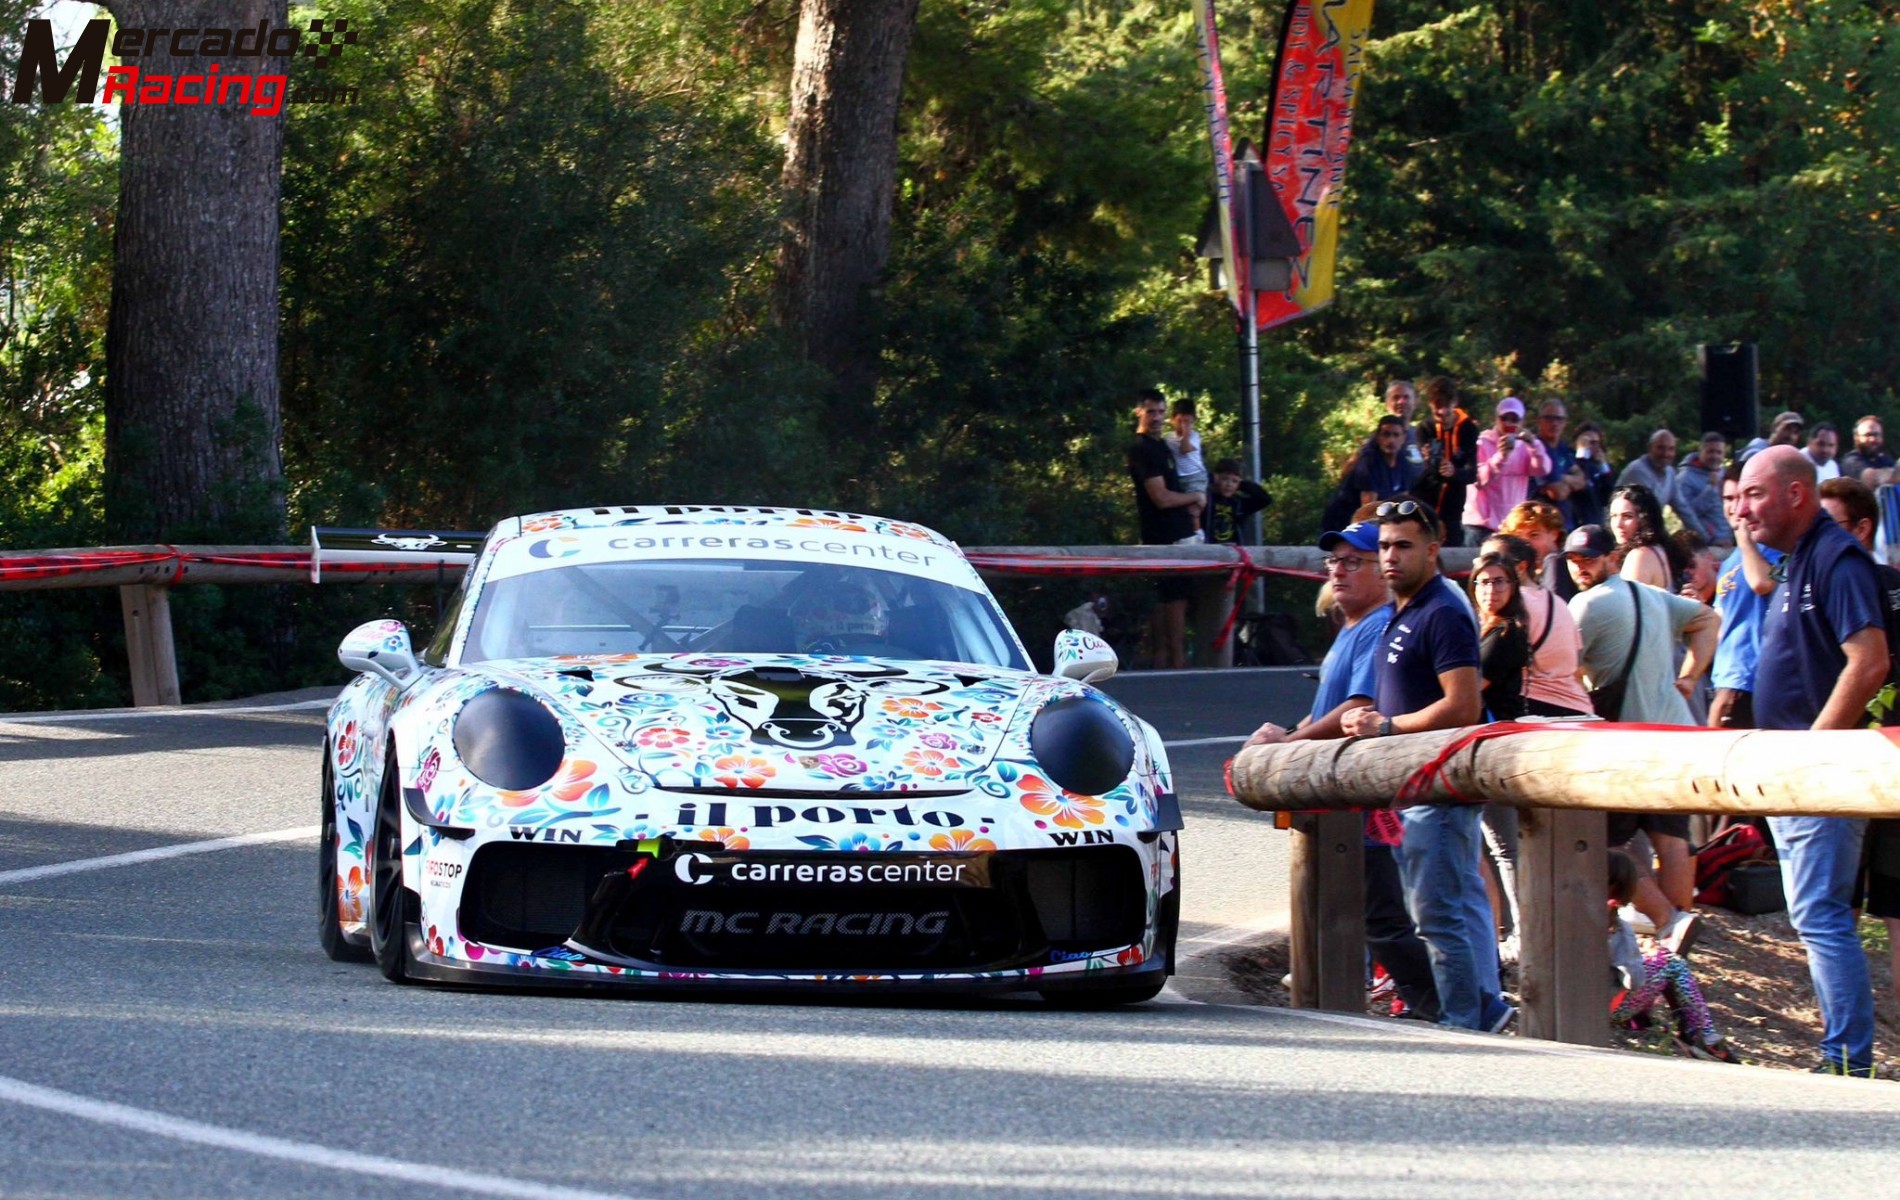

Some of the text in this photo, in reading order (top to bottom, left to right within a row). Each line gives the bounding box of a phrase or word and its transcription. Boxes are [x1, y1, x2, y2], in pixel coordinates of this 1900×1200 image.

[1283, 60, 1304, 80] &
[1272, 88, 1299, 156] SPICY
[1325, 27, 1368, 210] SALSA PICANTE
[608, 535, 938, 567] carrerascenter
[677, 802, 966, 828] il porto
[509, 826, 583, 843] WIN
[1048, 830, 1114, 847] WIN
[730, 859, 966, 883] carrerascenter
